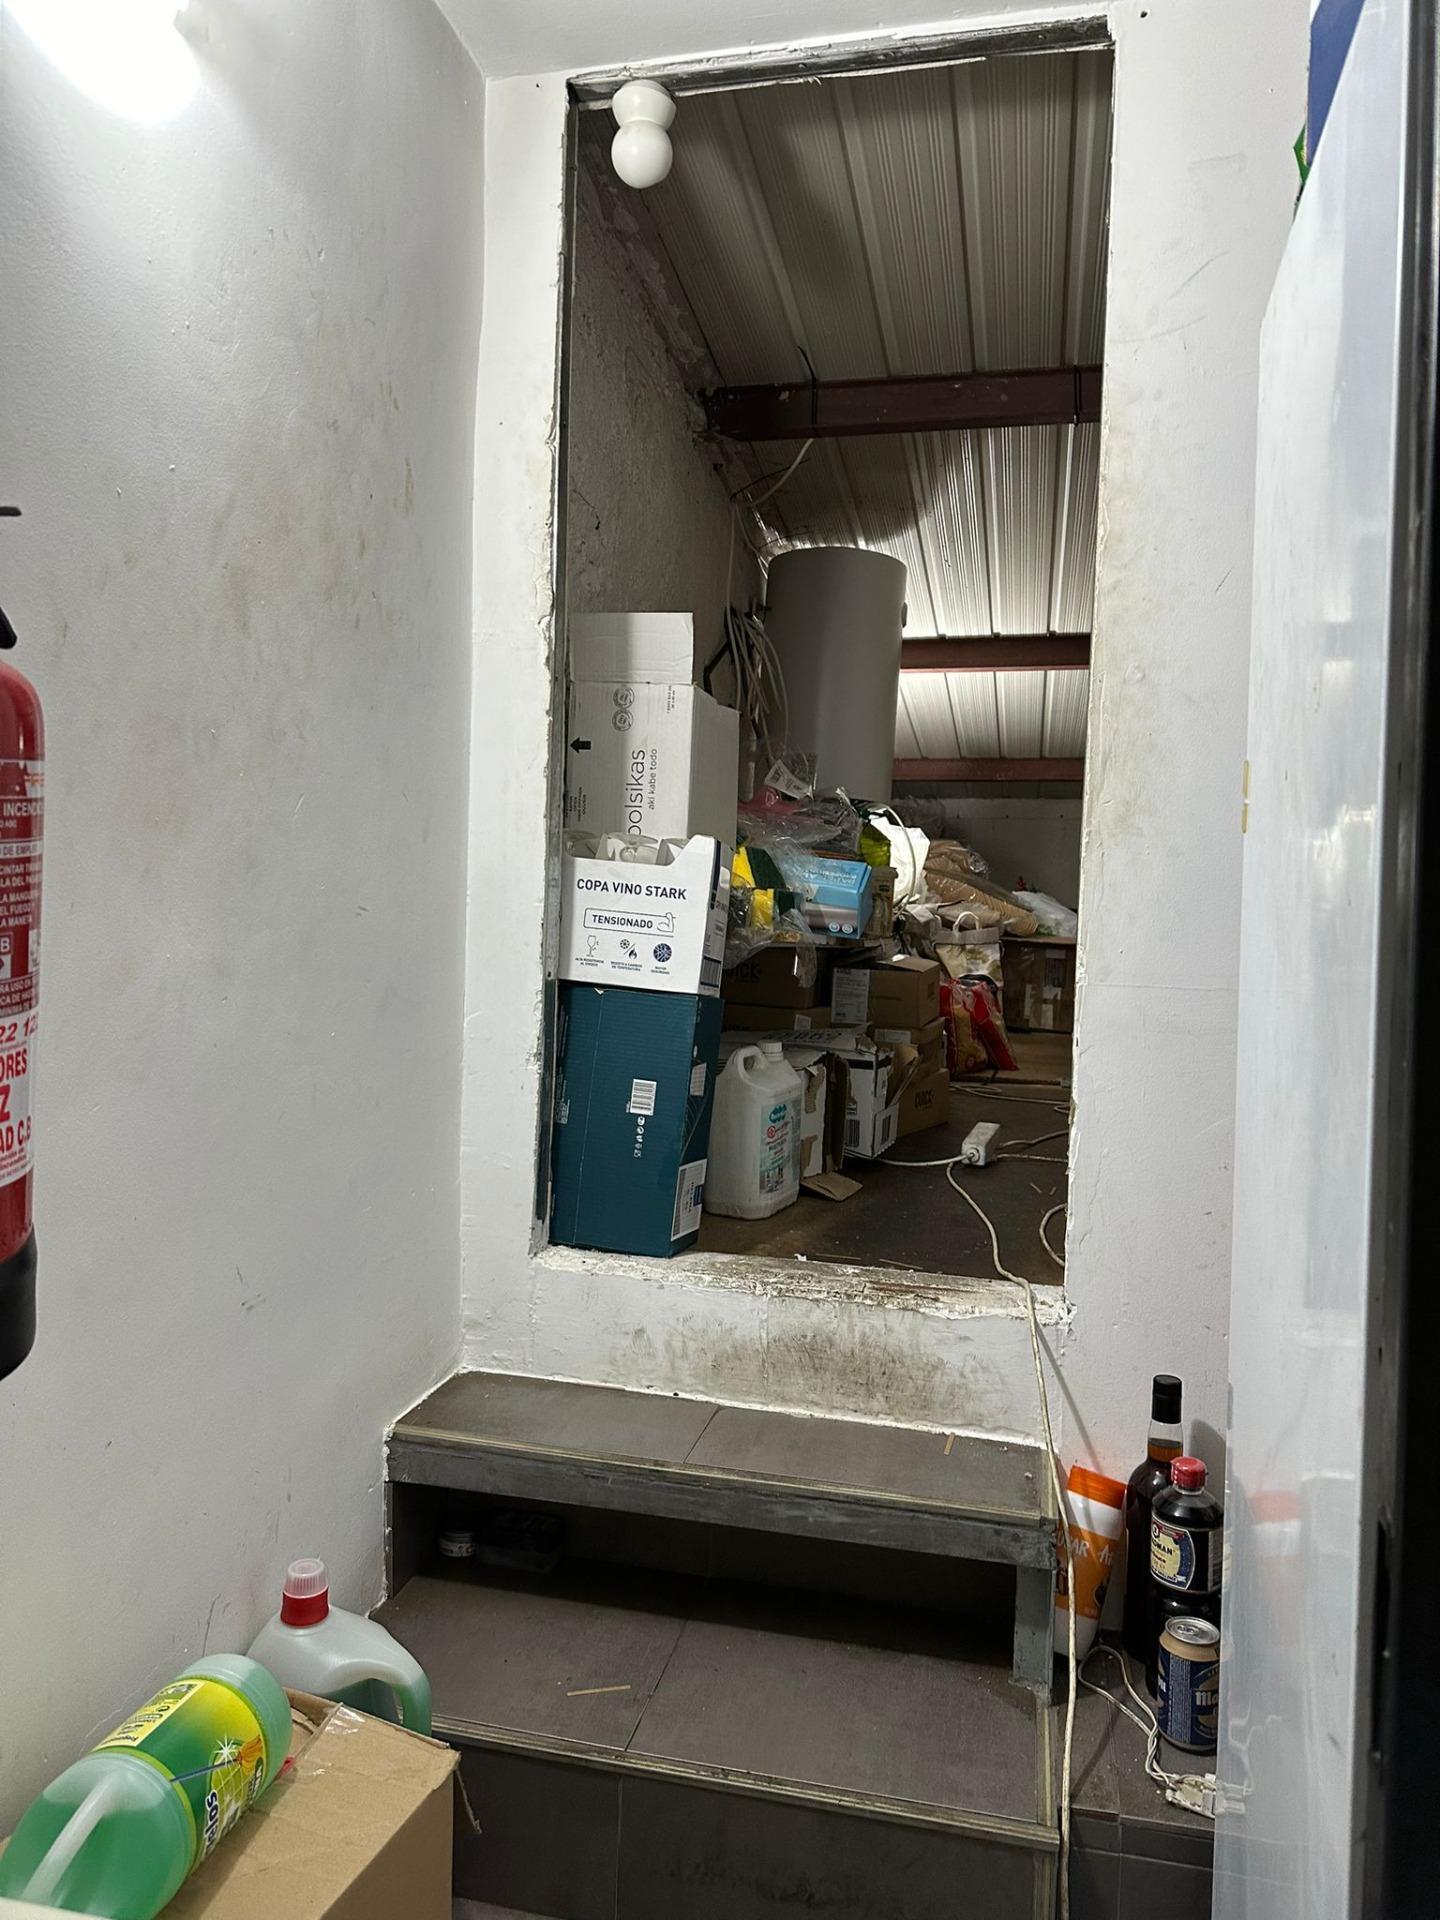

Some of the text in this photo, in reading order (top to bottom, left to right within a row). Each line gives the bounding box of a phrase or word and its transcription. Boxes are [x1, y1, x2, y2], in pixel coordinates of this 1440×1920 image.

[649, 748, 658, 771] todo
[577, 878, 687, 900] COPA VINO STARK
[592, 914, 653, 929] TENSIONADO
